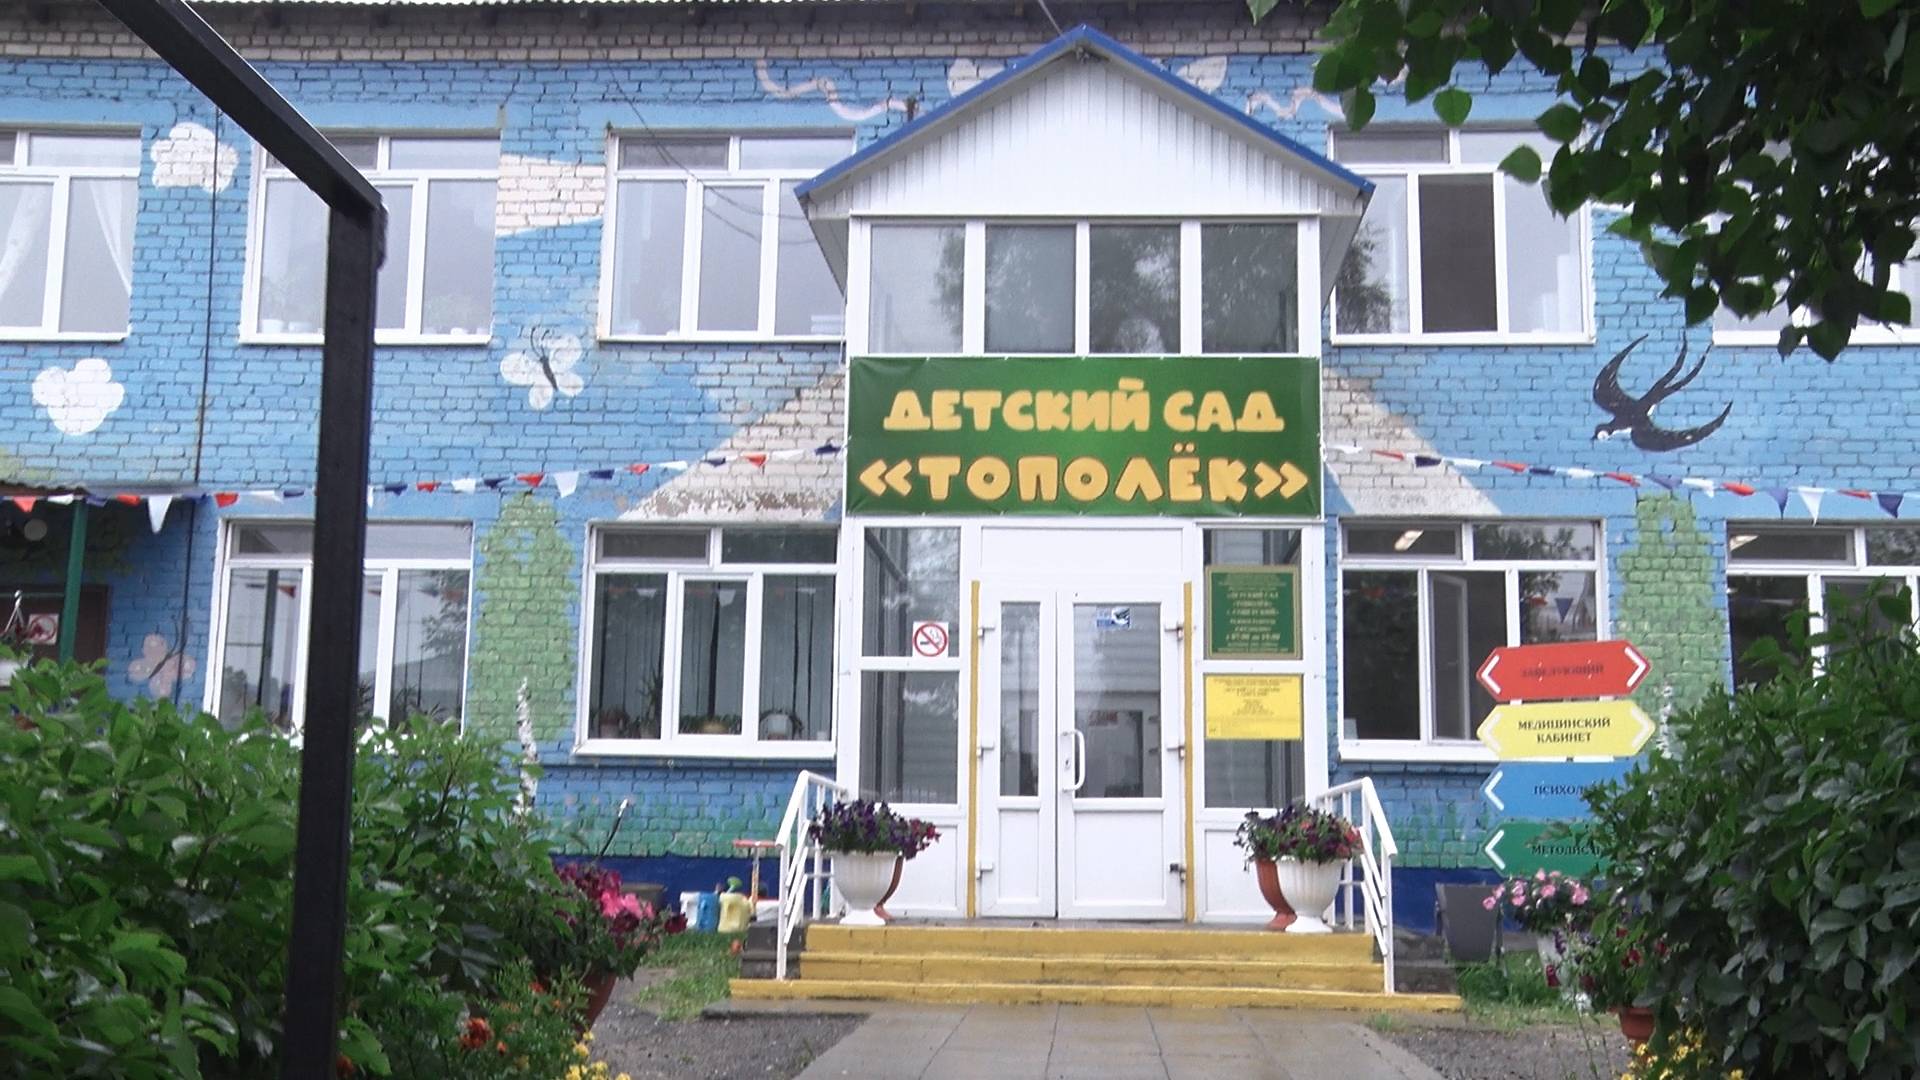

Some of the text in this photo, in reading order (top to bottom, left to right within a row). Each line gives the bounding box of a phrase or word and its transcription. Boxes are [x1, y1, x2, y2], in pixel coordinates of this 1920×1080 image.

[883, 377, 1285, 432] ДЕТСКИЙ САД
[1518, 717, 1611, 730] МЕДИЦИНСКИЙ
[1536, 732, 1592, 743] КАБИНЕТ
[1533, 784, 1584, 795] ПСИХОЛ
